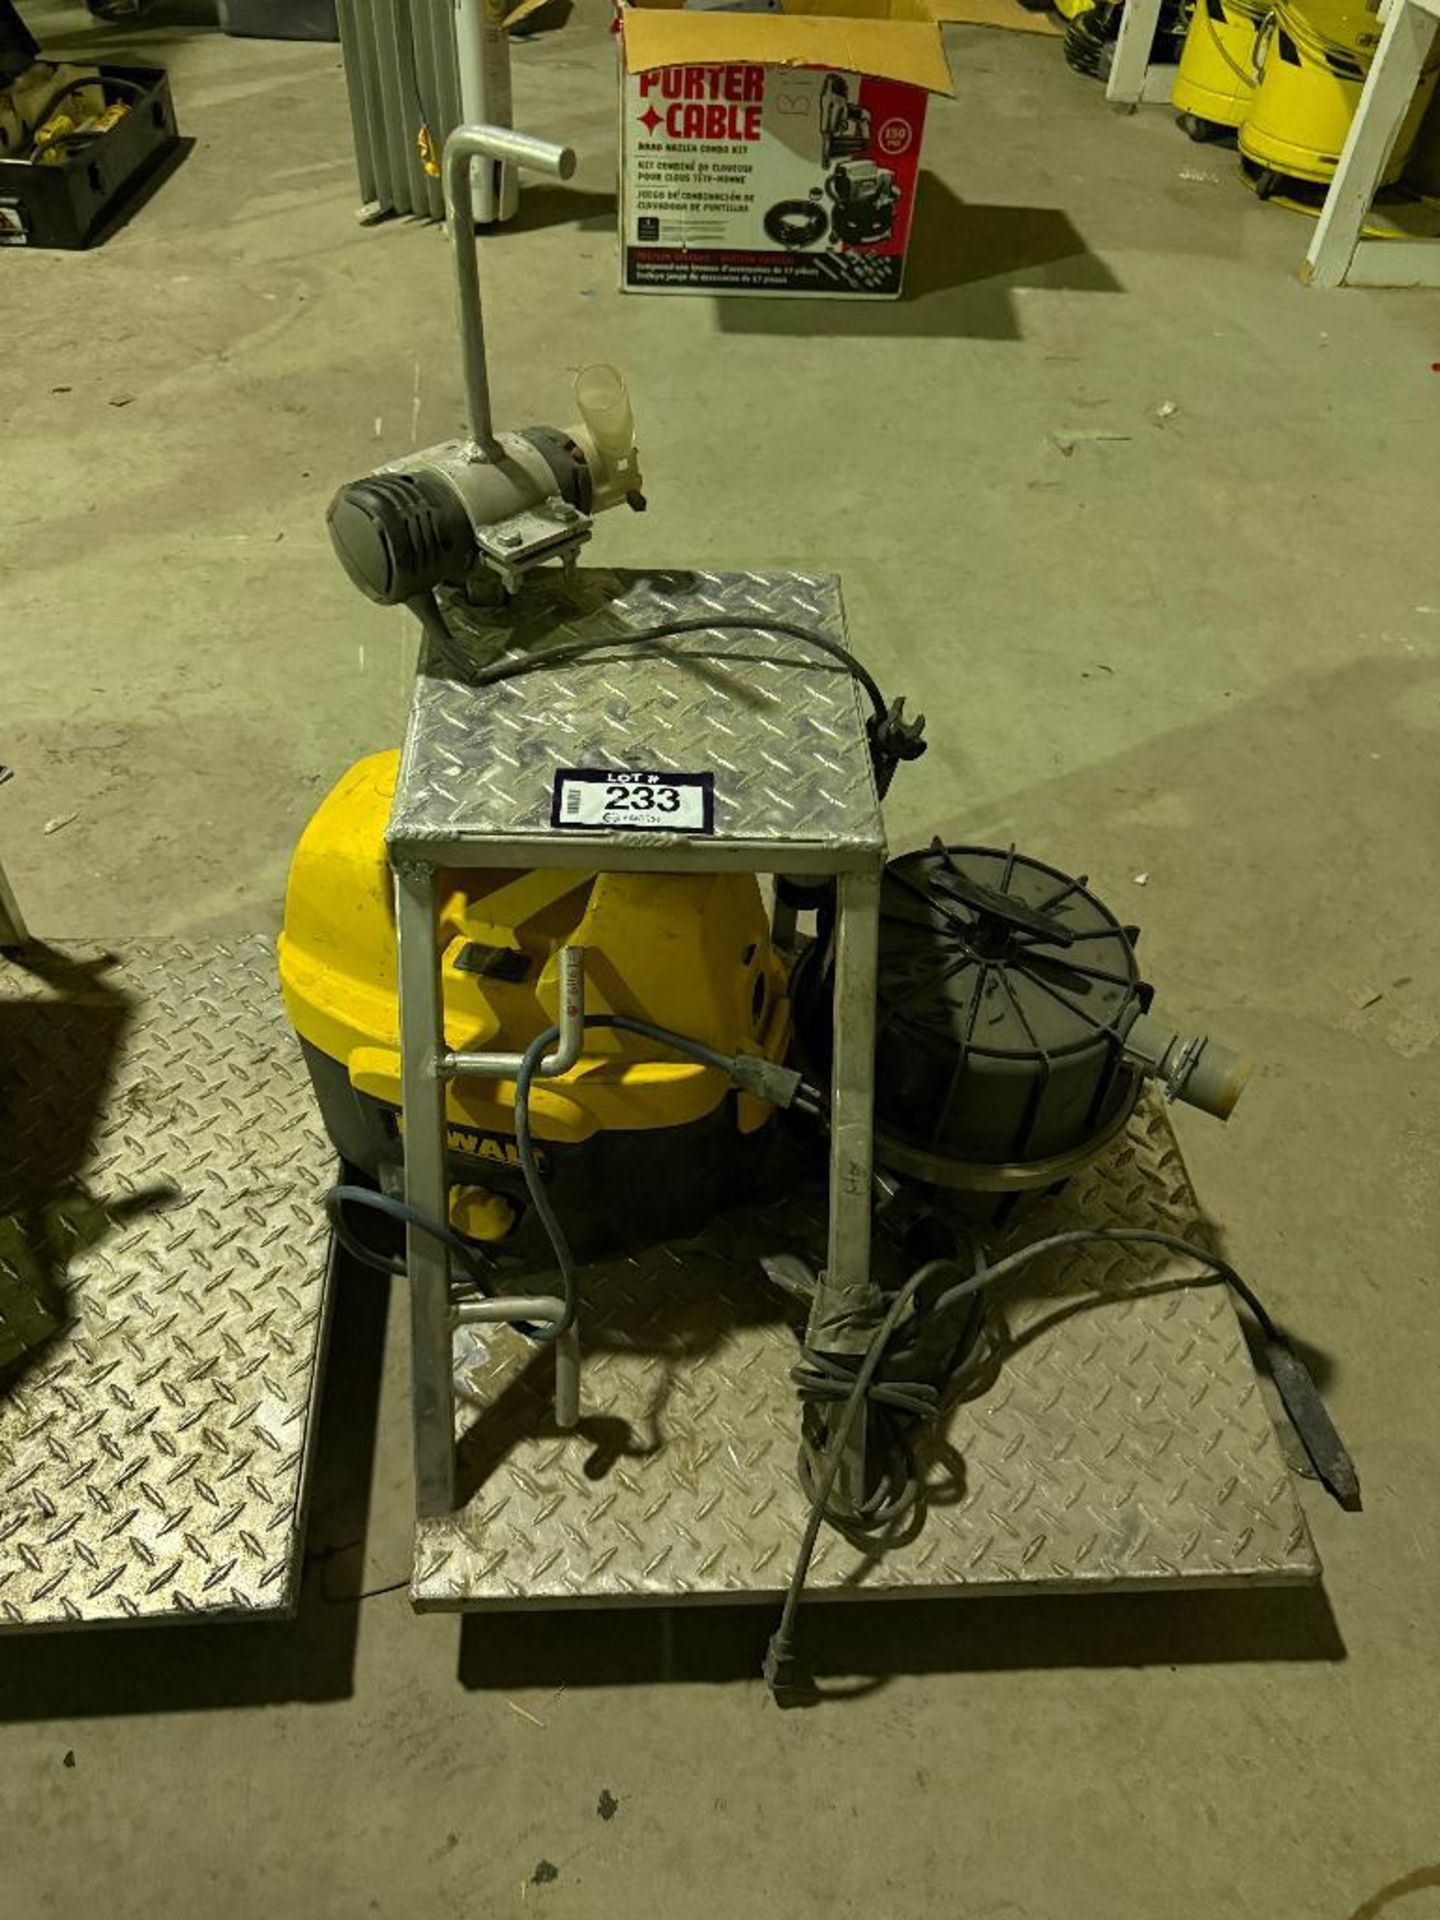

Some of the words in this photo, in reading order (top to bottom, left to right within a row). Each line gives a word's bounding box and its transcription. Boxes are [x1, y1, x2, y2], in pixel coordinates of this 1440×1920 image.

[640, 65, 764, 102] PORTER
[666, 103, 762, 141] CABLE
[665, 143, 698, 153] NAILER
[700, 145, 729, 154] COMBO
[731, 146, 748, 155] KIT
[638, 161, 655, 169] KIT
[638, 172, 662, 181] POUR
[638, 190, 665, 199] JUEGO
[606, 773, 643, 784] LOT
[647, 775, 660, 784] #
[604, 786, 681, 813] 233
